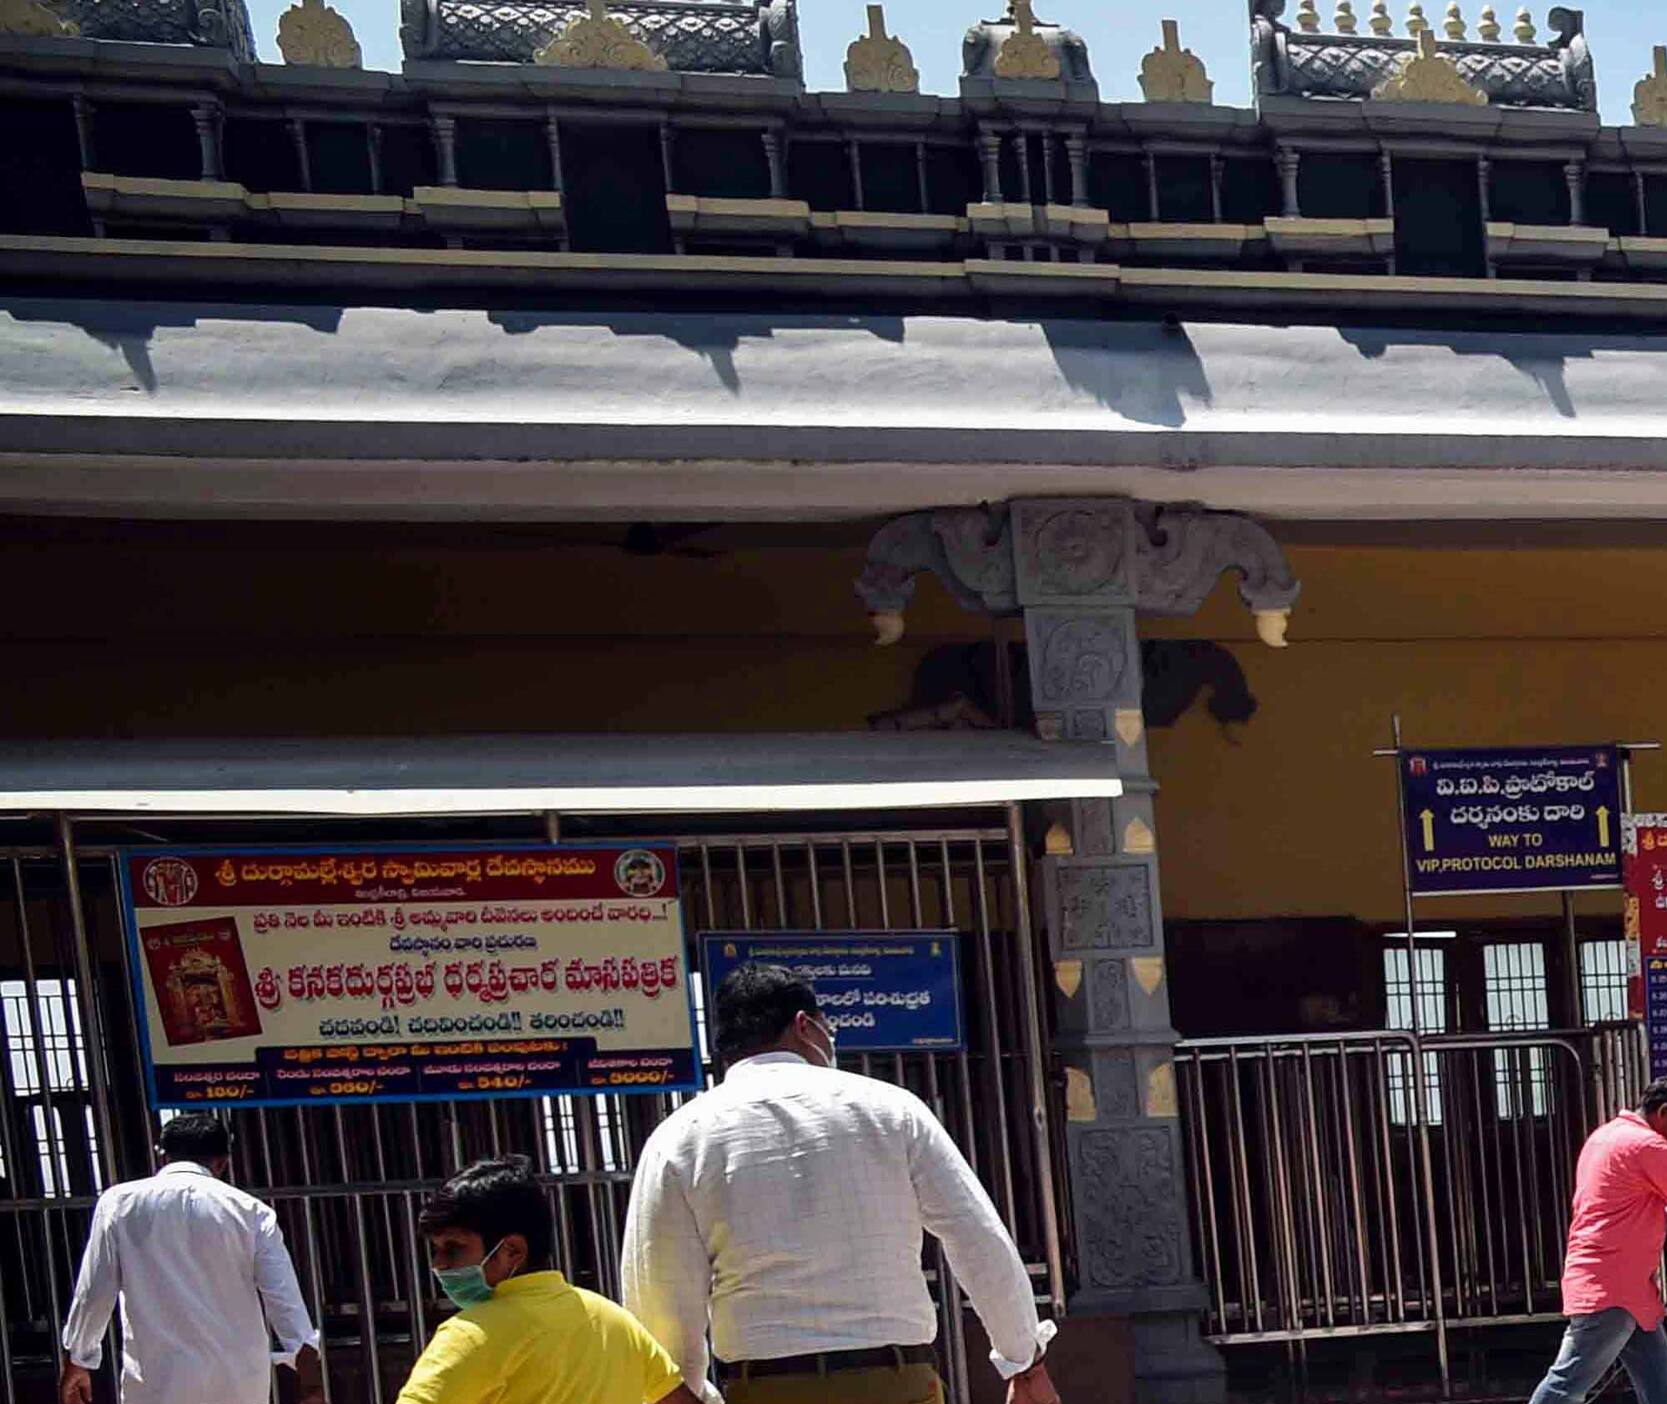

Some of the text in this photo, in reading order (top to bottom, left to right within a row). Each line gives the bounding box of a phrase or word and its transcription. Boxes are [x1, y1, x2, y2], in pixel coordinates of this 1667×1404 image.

[1544, 804, 1586, 821] దారి
[1488, 833, 1543, 848] WAY TO
[1524, 852, 1617, 869] DARSHANAM
[215, 858, 237, 887] శ్రీ
[486, 854, 597, 885] దేవస్థానము
[1652, 869, 1665, 890] శ్రీ
[253, 911, 280, 934] ప్రతి
[284, 911, 310, 928] నెల
[313, 909, 333, 928] మీ
[337, 909, 386, 927] ఇంటికి
[390, 905, 405, 931] శ్రీ
[454, 935, 482, 951] వారి
[254, 965, 282, 1010] శ్రీ
[443, 958, 558, 1004] ధర్మప్రచార
[564, 954, 680, 999] మాసపత్రిక
